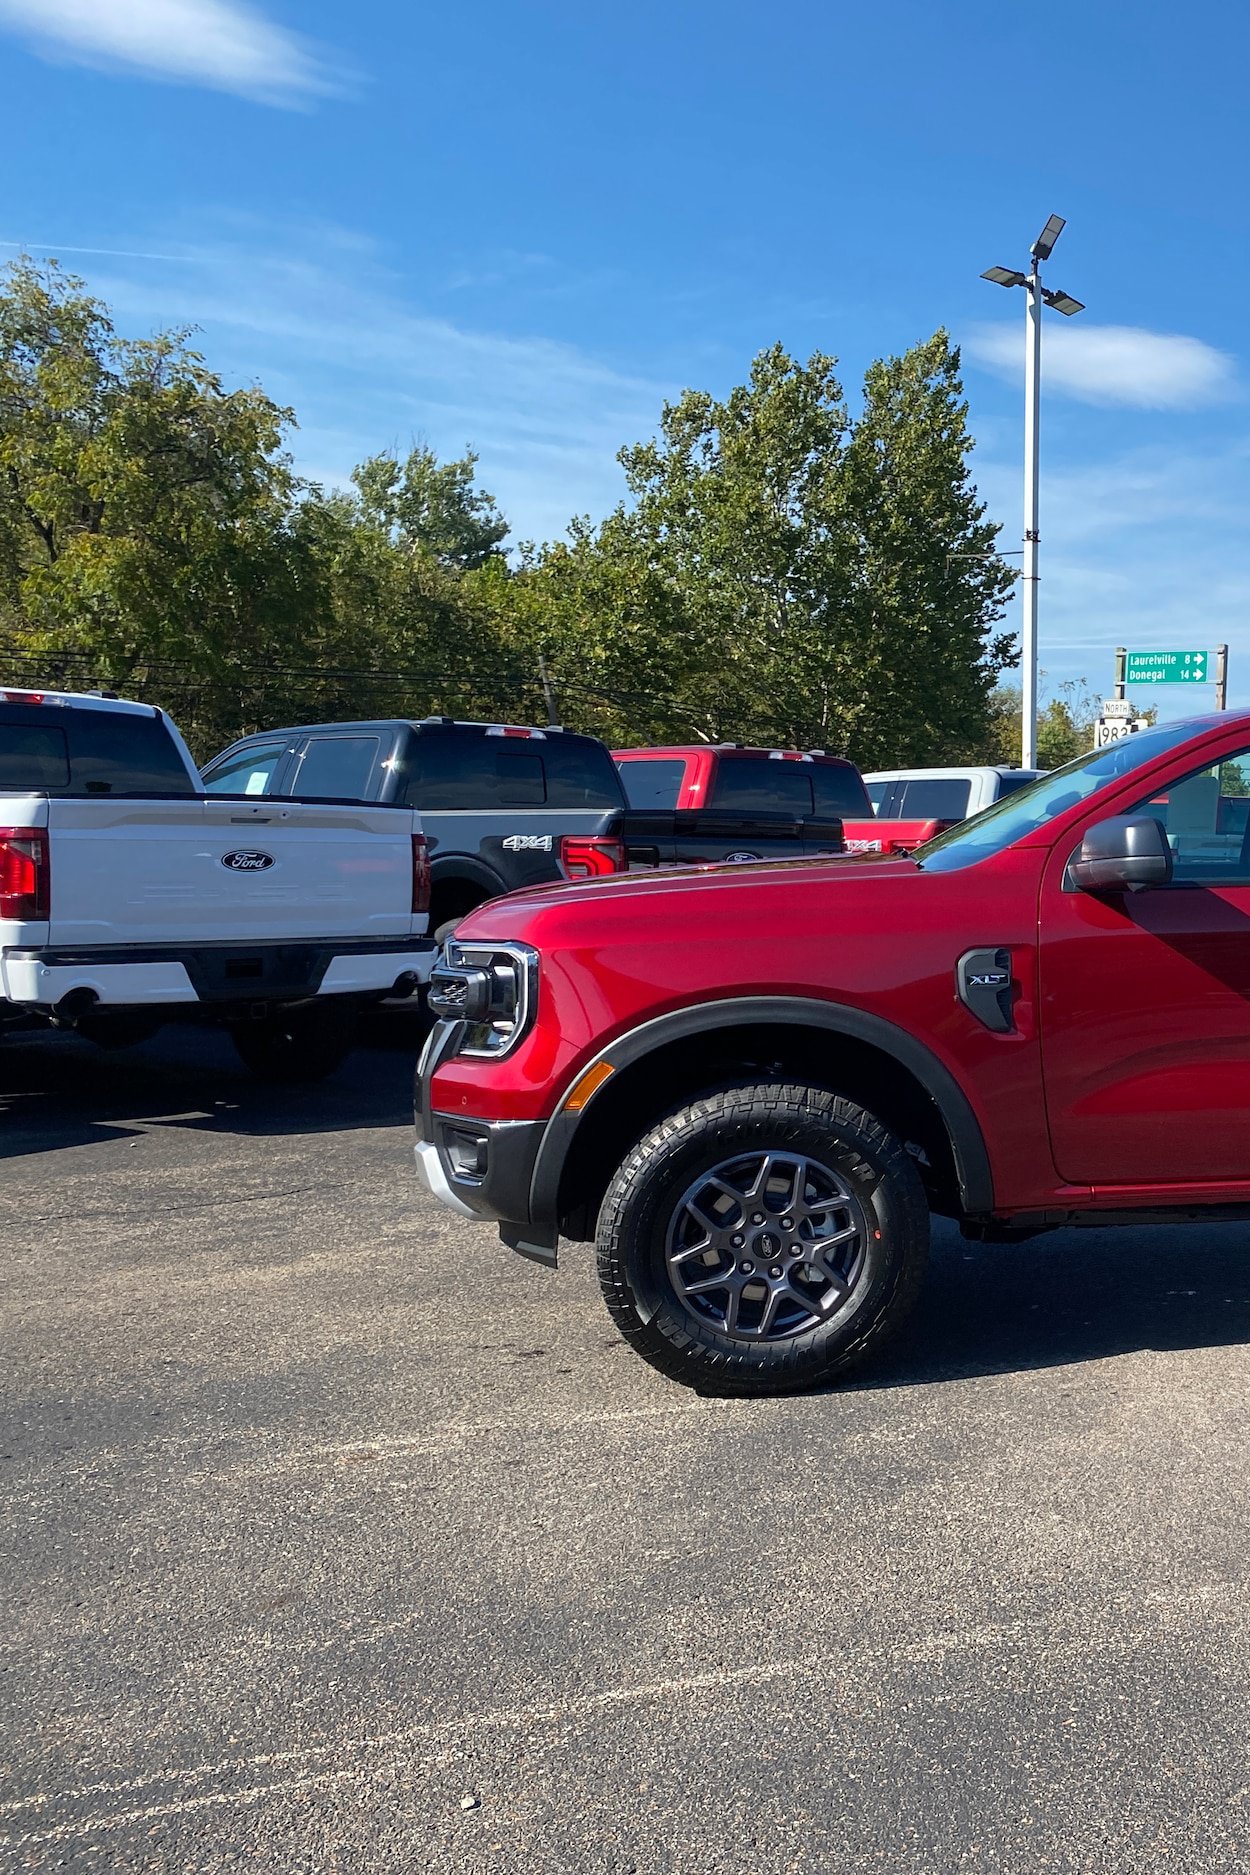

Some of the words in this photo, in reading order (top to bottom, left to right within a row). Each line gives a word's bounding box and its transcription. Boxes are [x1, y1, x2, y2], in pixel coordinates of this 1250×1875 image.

[1130, 654, 1177, 666] Laurelville
[1184, 654, 1191, 665] 8
[1129, 668, 1166, 683] Donegal
[1180, 669, 1190, 680] 14
[1105, 703, 1128, 713] NORTH
[231, 853, 266, 868] Ford
[969, 974, 1007, 986] XLT
